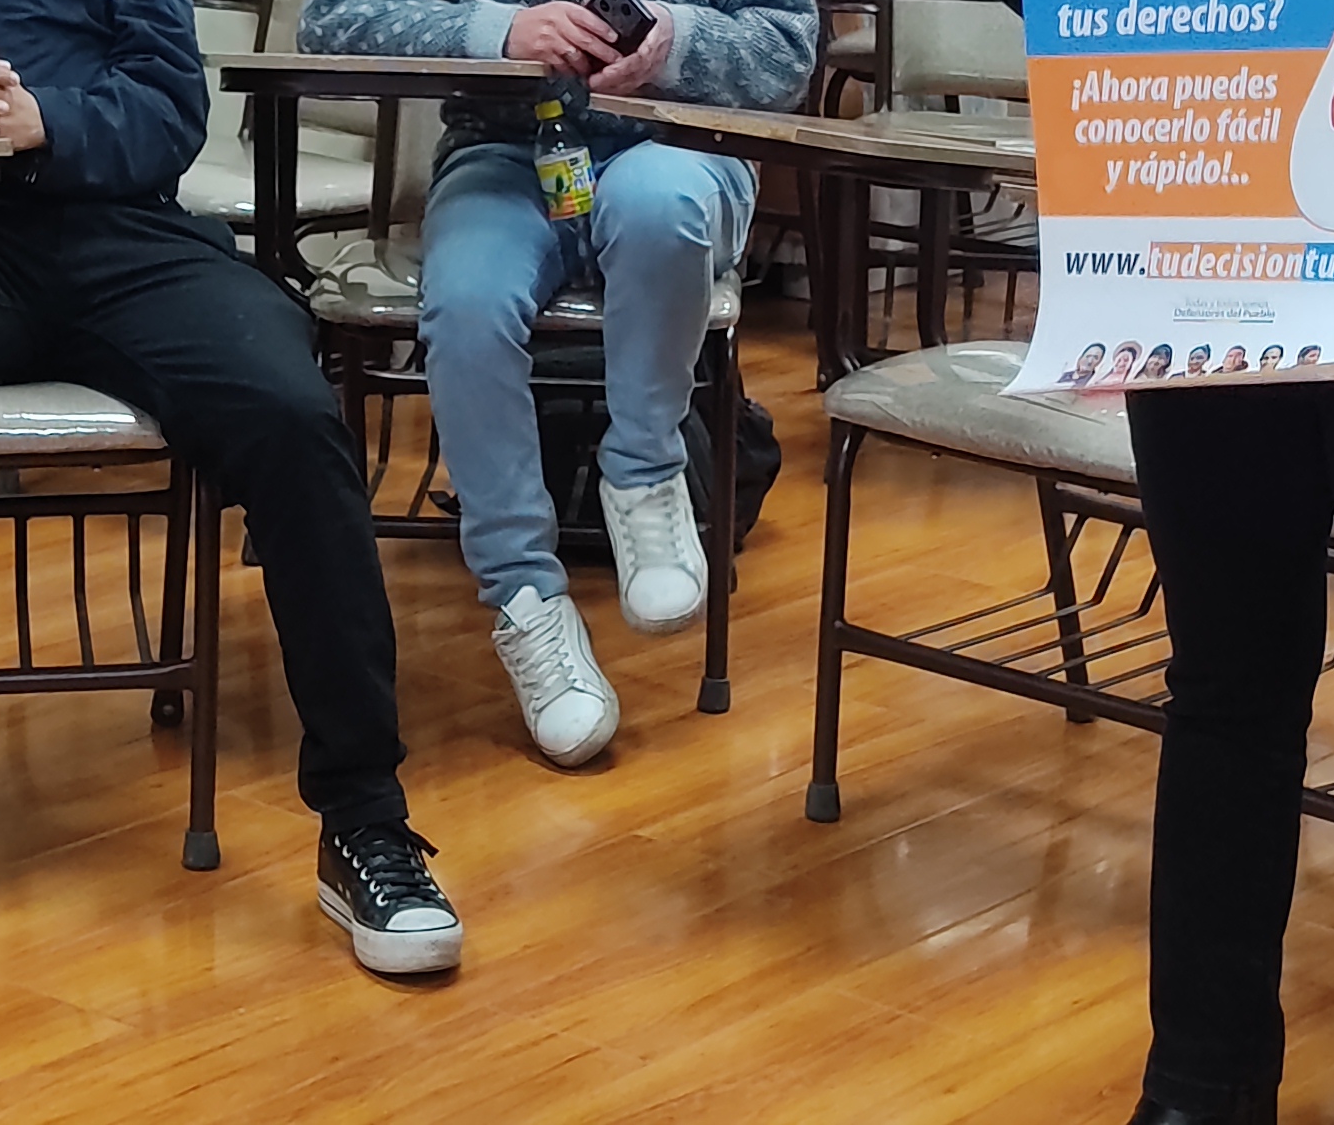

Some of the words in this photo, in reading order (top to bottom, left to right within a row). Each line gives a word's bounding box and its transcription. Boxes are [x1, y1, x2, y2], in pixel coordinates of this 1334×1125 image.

[1057, 0, 1109, 38] tus
[1071, 66, 1169, 112] ¡Ahora
[1174, 65, 1279, 110] puedes
[1074, 107, 1211, 146] conocerlo
[1215, 107, 1281, 144] fácil
[1104, 159, 1127, 194] y
[1126, 149, 1250, 195] rápido!..
